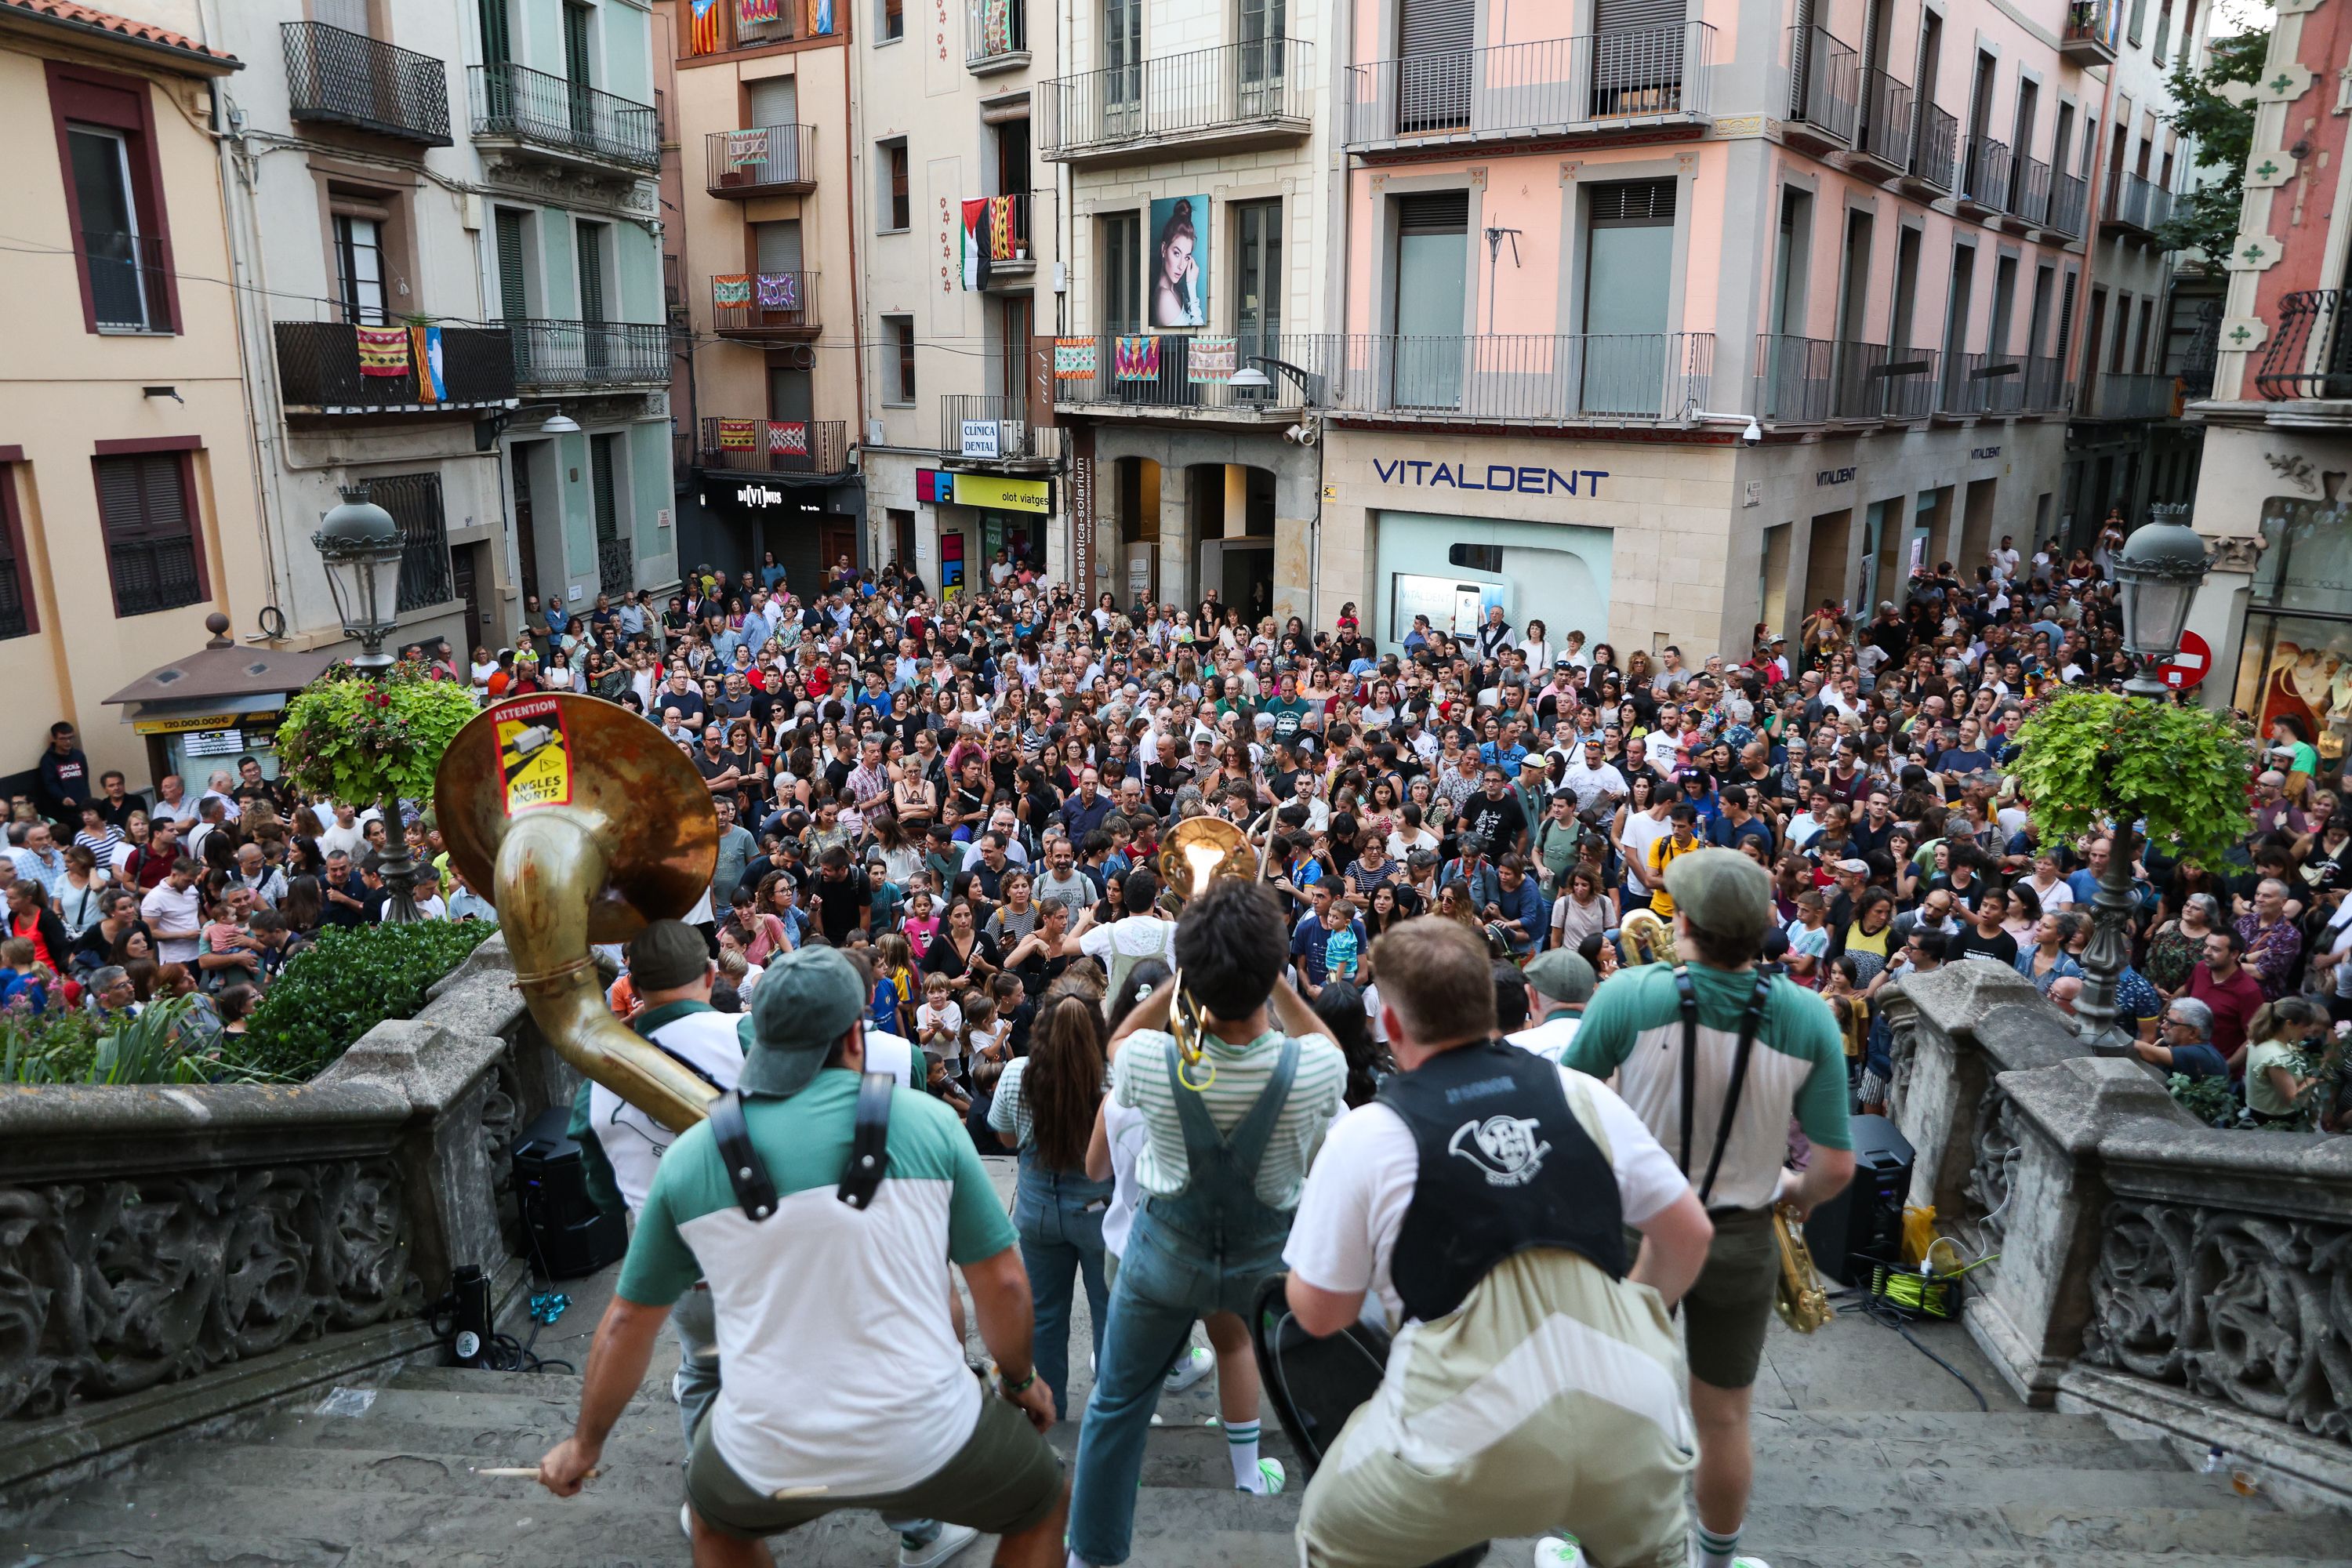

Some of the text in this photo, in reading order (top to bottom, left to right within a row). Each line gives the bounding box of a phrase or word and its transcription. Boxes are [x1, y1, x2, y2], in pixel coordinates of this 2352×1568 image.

[964, 423, 995, 436] CLÍNICA
[965, 441, 995, 452] DENTAL
[1971, 446, 2001, 460] VITALDENT
[1373, 458, 1610, 497] VITALDENT
[1817, 466, 1857, 487] VITALDENT
[1002, 492, 1049, 506] olot viatges
[1402, 589, 1451, 603] VITALDENT
[495, 699, 557, 721] ATTENTION
[1484, 750, 1523, 763] adidas
[513, 775, 561, 792] ANGLES
[514, 787, 559, 804] MORTS
